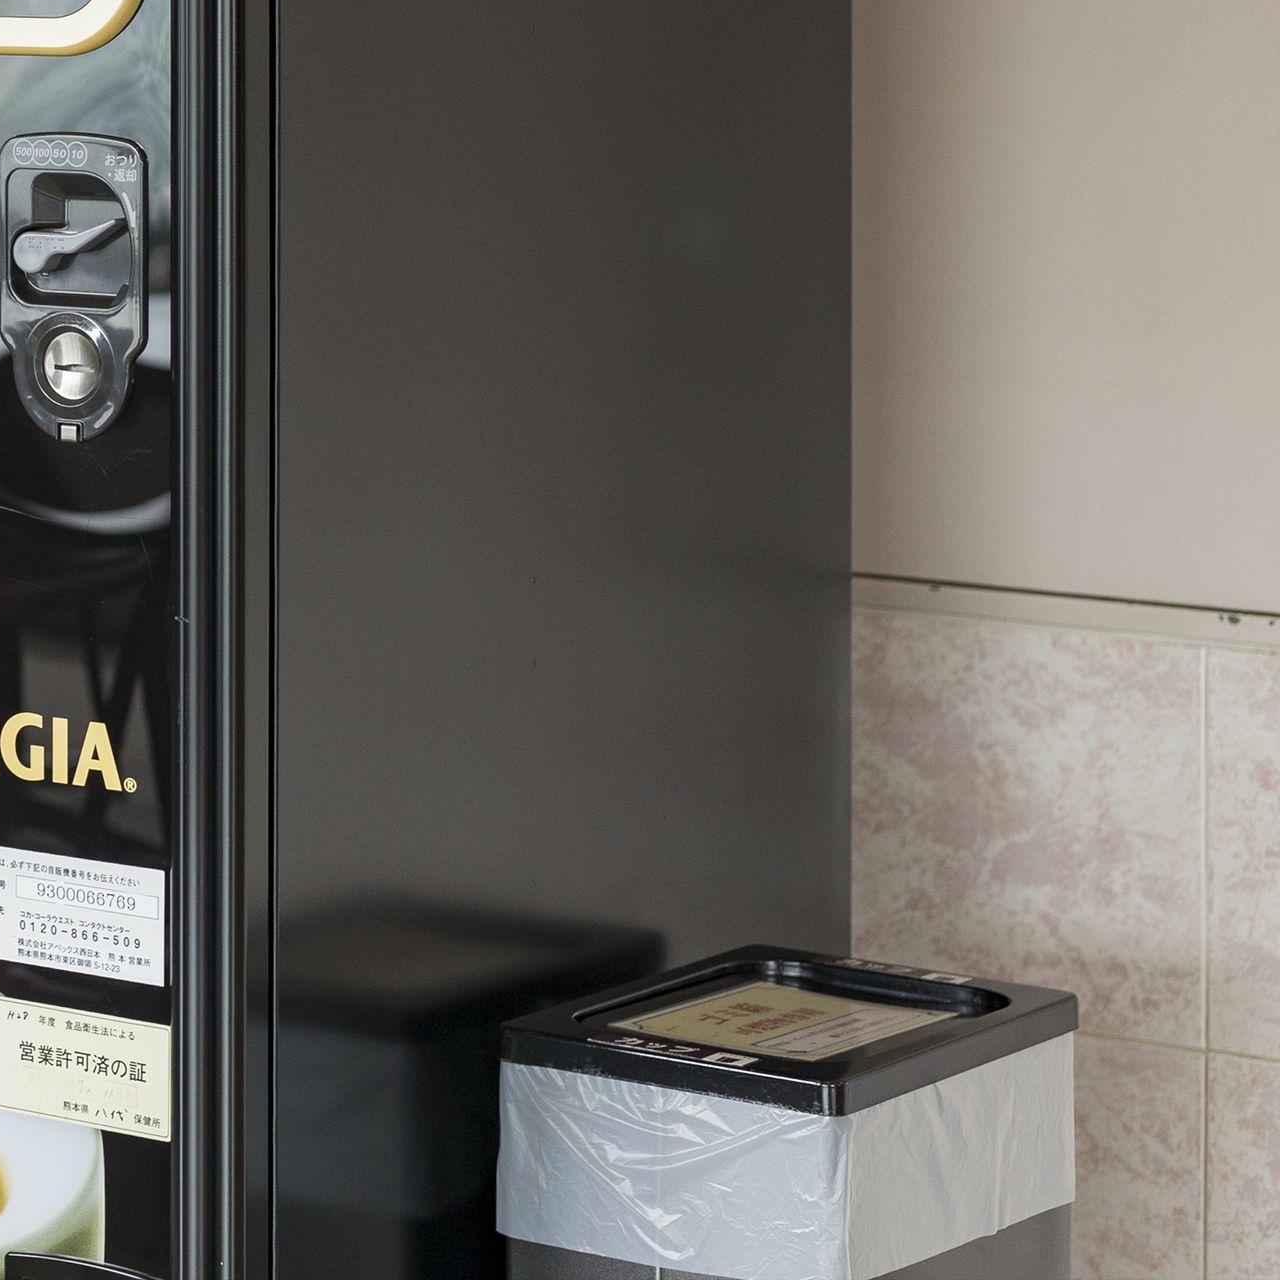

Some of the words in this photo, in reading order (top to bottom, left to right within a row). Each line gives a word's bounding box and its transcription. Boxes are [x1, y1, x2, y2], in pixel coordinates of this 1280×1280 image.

[15, 147, 33, 157] 500
[34, 148, 50, 158] 100
[52, 149, 67, 159] 50
[71, 149, 84, 160] 10
[104, 154, 137, 167] おつり
[36, 882, 136, 911] 9300066769
[19, 919, 141, 950] 0120-866-509
[78, 919, 131, 934] コンタクトセンター
[17, 948, 91, 969] 熊本県熊本市東区御領
[93, 961, 121, 973] 5-12-23
[108, 952, 152, 968] 熊本営業所
[38, 1015, 56, 1028] 年度
[65, 1020, 136, 1041] 食品衛生法による
[19, 1040, 148, 1083] 営業許可済の証
[63, 1100, 90, 1115] 熊本県
[133, 1114, 161, 1129] 保健所
